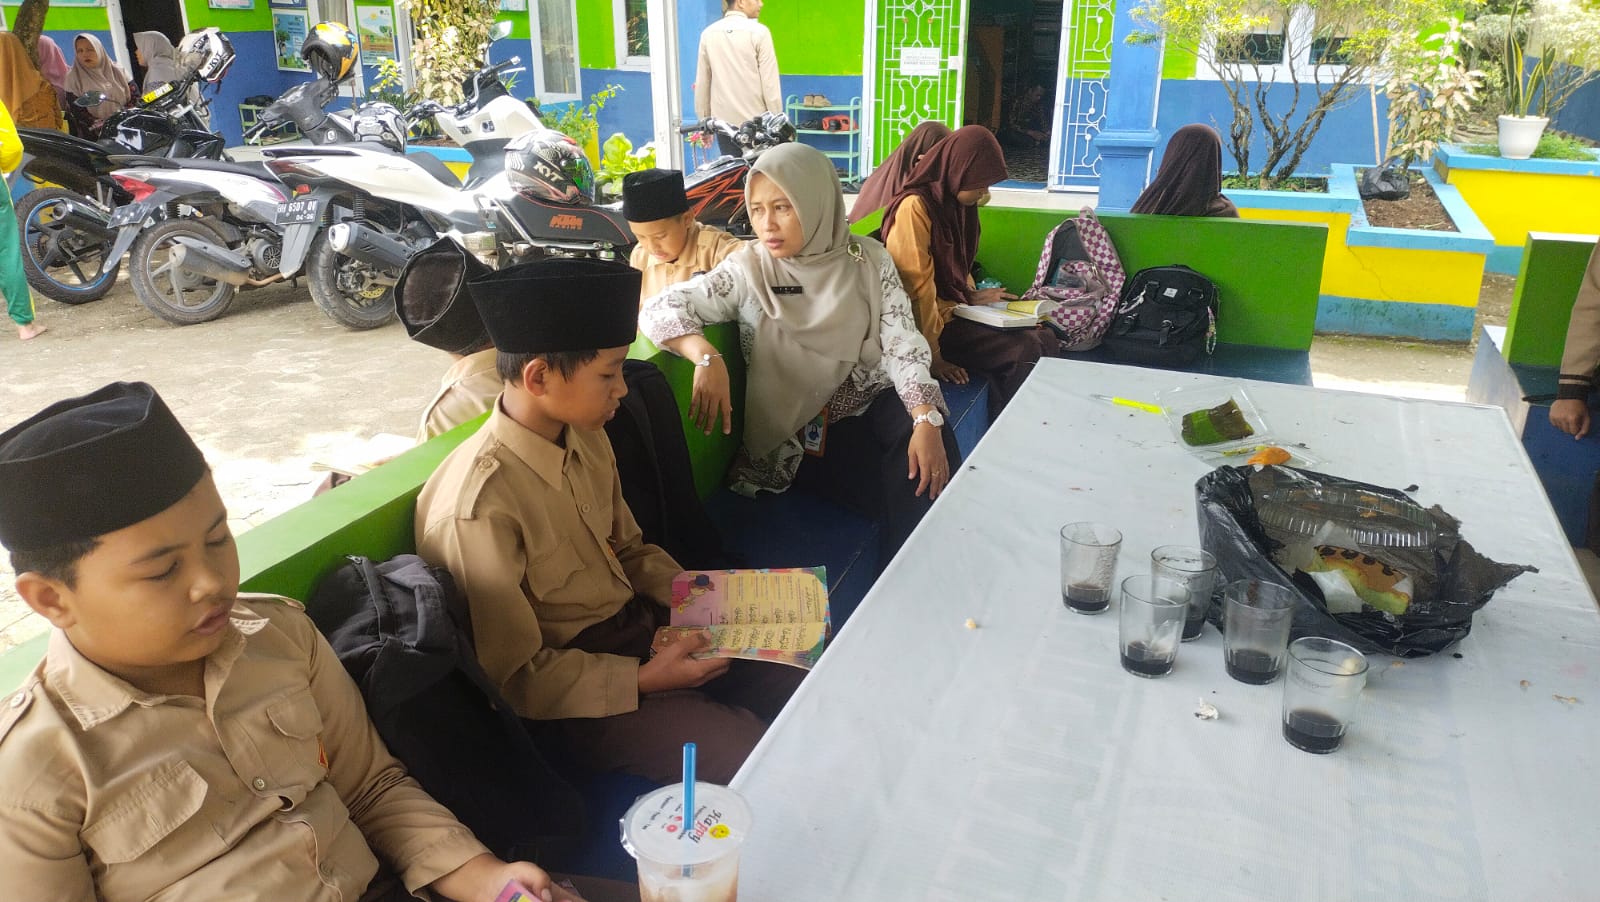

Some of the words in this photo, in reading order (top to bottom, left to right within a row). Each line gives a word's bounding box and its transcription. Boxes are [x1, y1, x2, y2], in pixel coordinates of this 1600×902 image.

[533, 161, 565, 182] KYT
[288, 201, 305, 212] 6507
[687, 809, 723, 844] Happy
